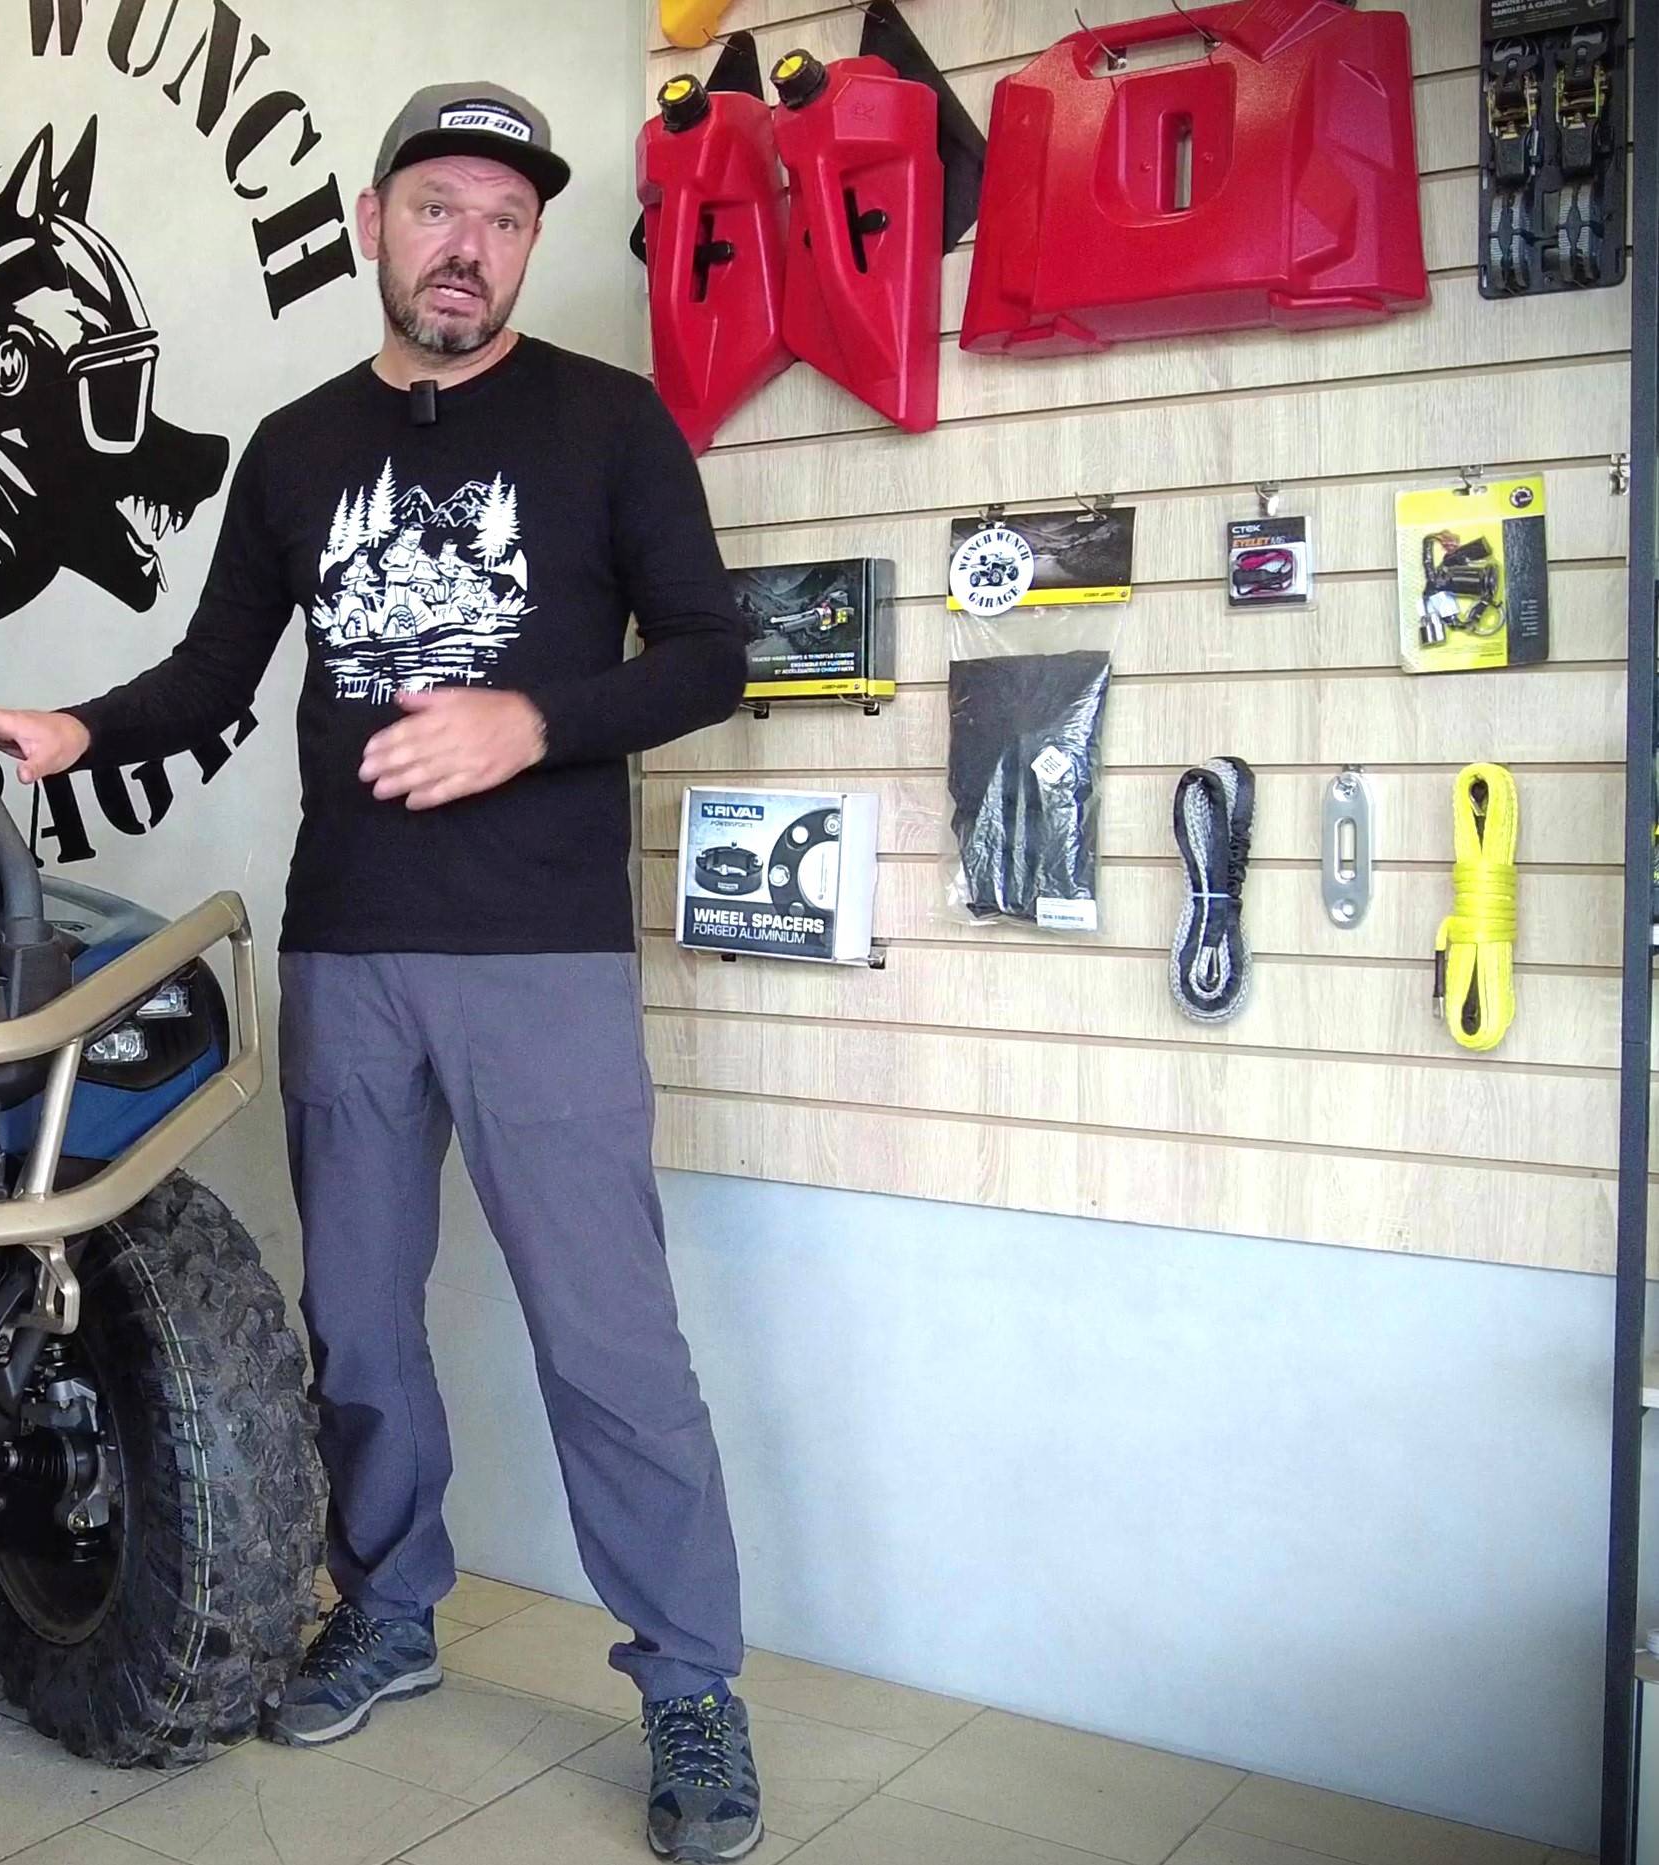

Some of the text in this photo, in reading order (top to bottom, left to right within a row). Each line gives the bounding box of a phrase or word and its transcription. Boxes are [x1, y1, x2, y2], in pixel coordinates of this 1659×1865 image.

[448, 115, 525, 137] can-am
[26, 0, 358, 321] WUNCH
[1232, 525, 1261, 534] CTEK
[958, 532, 1031, 571] WUNCH WUNCH
[968, 586, 1021, 608] GARAGE
[714, 805, 762, 818] RIVAL
[694, 908, 825, 934] WHEEL SPACERS
[693, 923, 806, 944] FORGED ALUMINIUM
